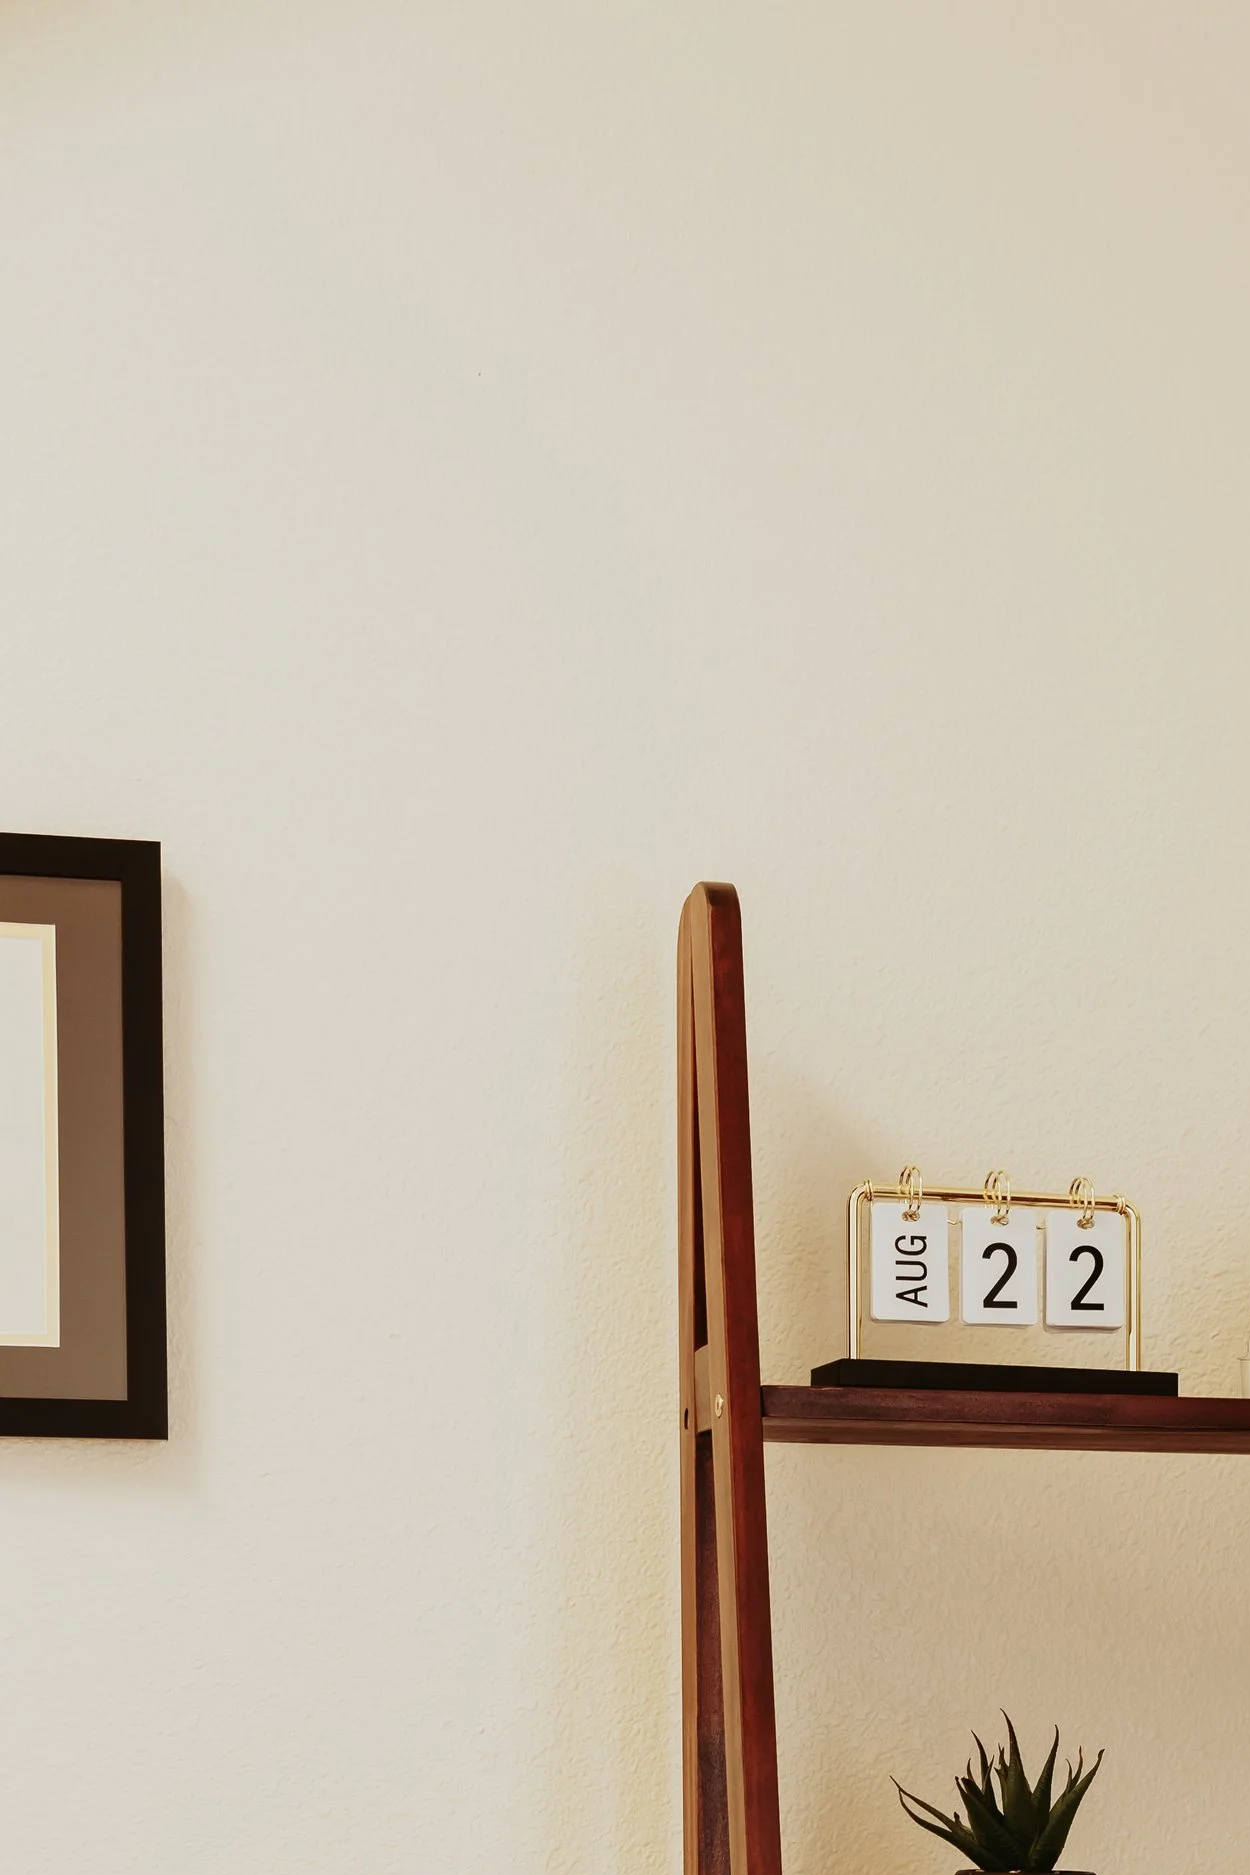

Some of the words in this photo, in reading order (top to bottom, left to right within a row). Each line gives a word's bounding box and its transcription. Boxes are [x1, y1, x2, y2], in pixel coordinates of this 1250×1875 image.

[895, 1235, 928, 1308] AUG
[981, 1242, 1018, 1309] 2
[1068, 1245, 1105, 1311] 2
